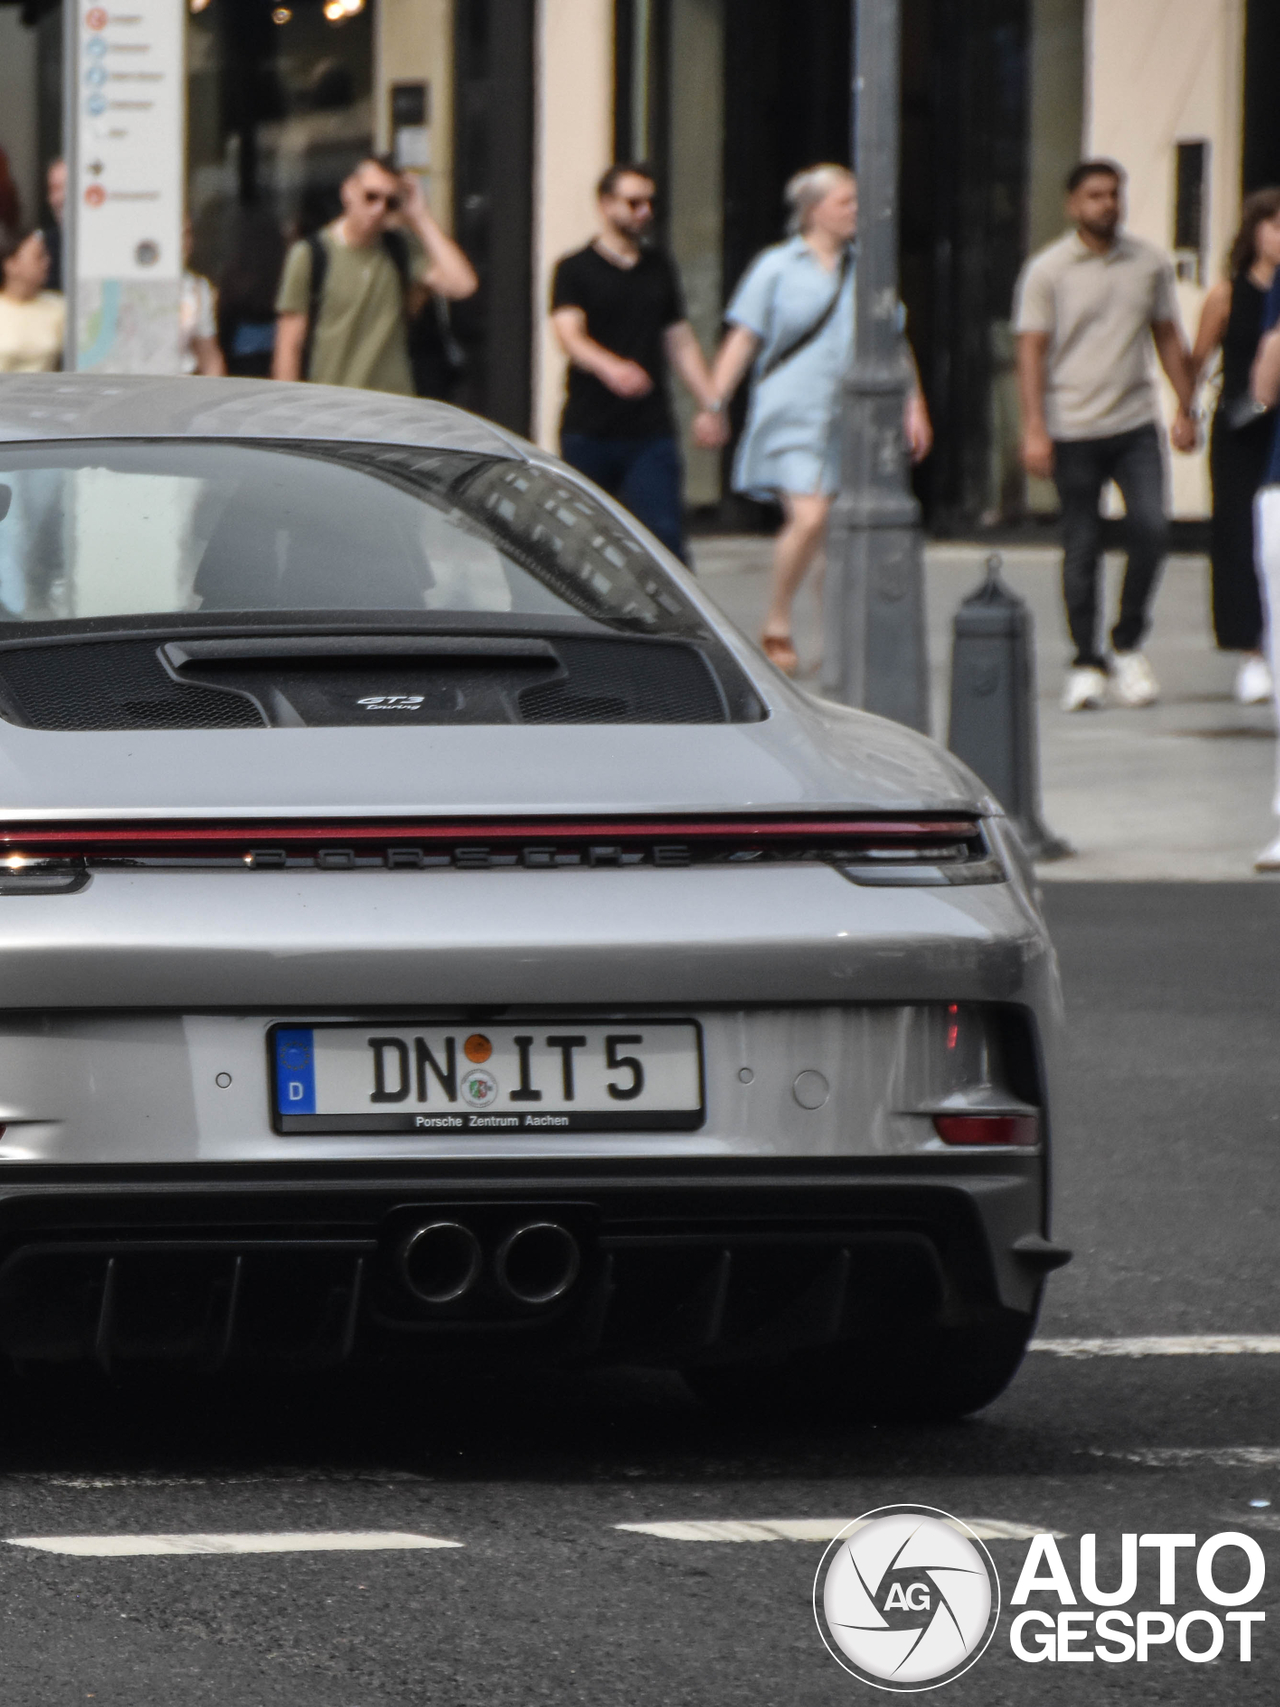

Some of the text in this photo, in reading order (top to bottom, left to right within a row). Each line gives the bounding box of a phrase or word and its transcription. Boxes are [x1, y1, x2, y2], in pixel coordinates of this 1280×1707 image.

[356, 695, 425, 705] GT3
[247, 846, 692, 869] PORSCHE
[367, 1033, 645, 1103] DN IT 5
[289, 1082, 304, 1101] D
[415, 1115, 569, 1128] Porsche Zentrum Aachen
